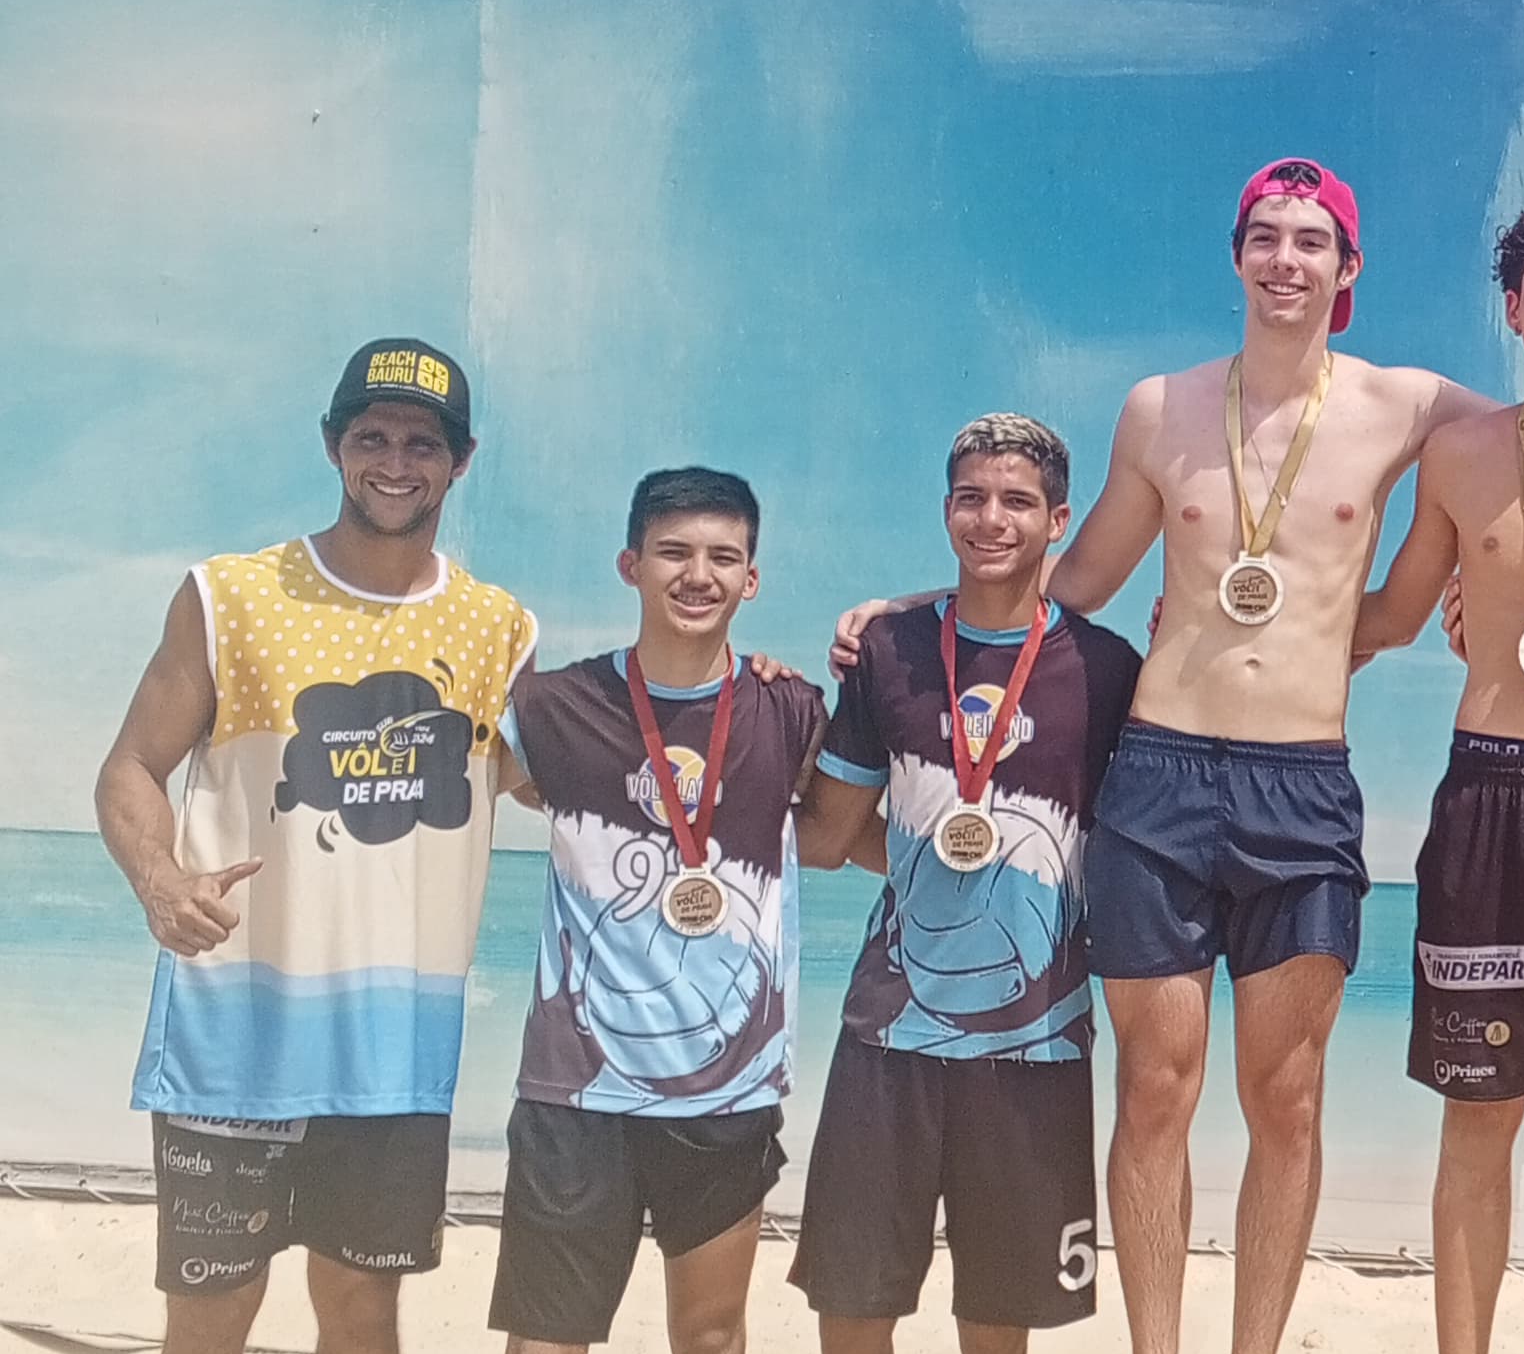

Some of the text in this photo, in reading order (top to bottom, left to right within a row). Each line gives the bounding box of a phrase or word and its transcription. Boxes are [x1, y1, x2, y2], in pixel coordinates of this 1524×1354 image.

[370, 351, 416, 367] BEACH
[367, 366, 414, 384] BAURU
[322, 730, 377, 743] CIRCUITO
[940, 712, 1035, 743] VLEIND
[330, 742, 416, 778] VÔLEI
[343, 779, 424, 804] DE PRAA
[1432, 960, 1524, 981] INDEPAR
[1451, 1064, 1497, 1077] Prince
[342, 1247, 416, 1268] M.CABRAL
[1058, 1219, 1097, 1291] 5
